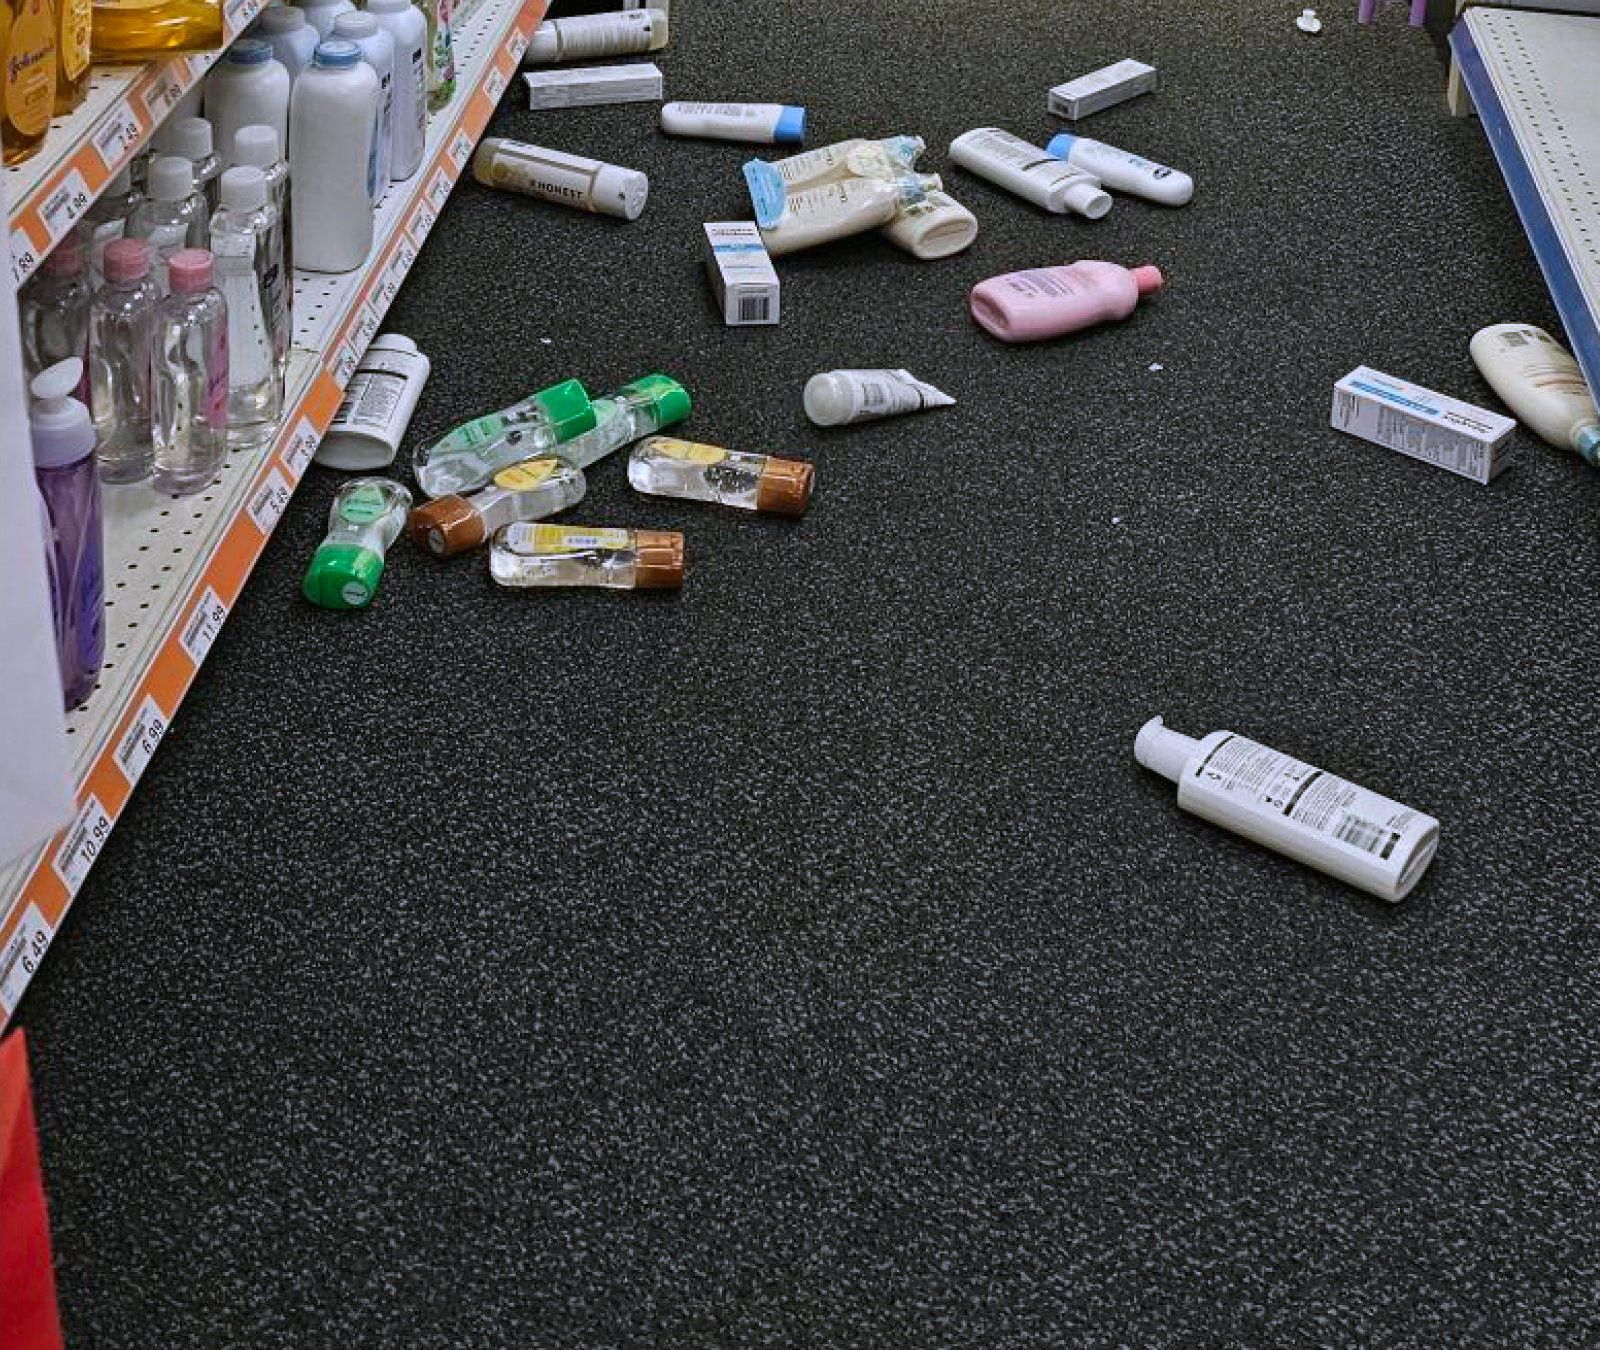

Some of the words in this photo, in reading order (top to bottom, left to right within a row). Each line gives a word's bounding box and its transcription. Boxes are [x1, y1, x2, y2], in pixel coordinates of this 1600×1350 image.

[202, 605, 227, 643] 11.99
[142, 719, 164, 754] 6.99
[80, 815, 109, 864] 10.99
[22, 931, 49, 974] 6.49
